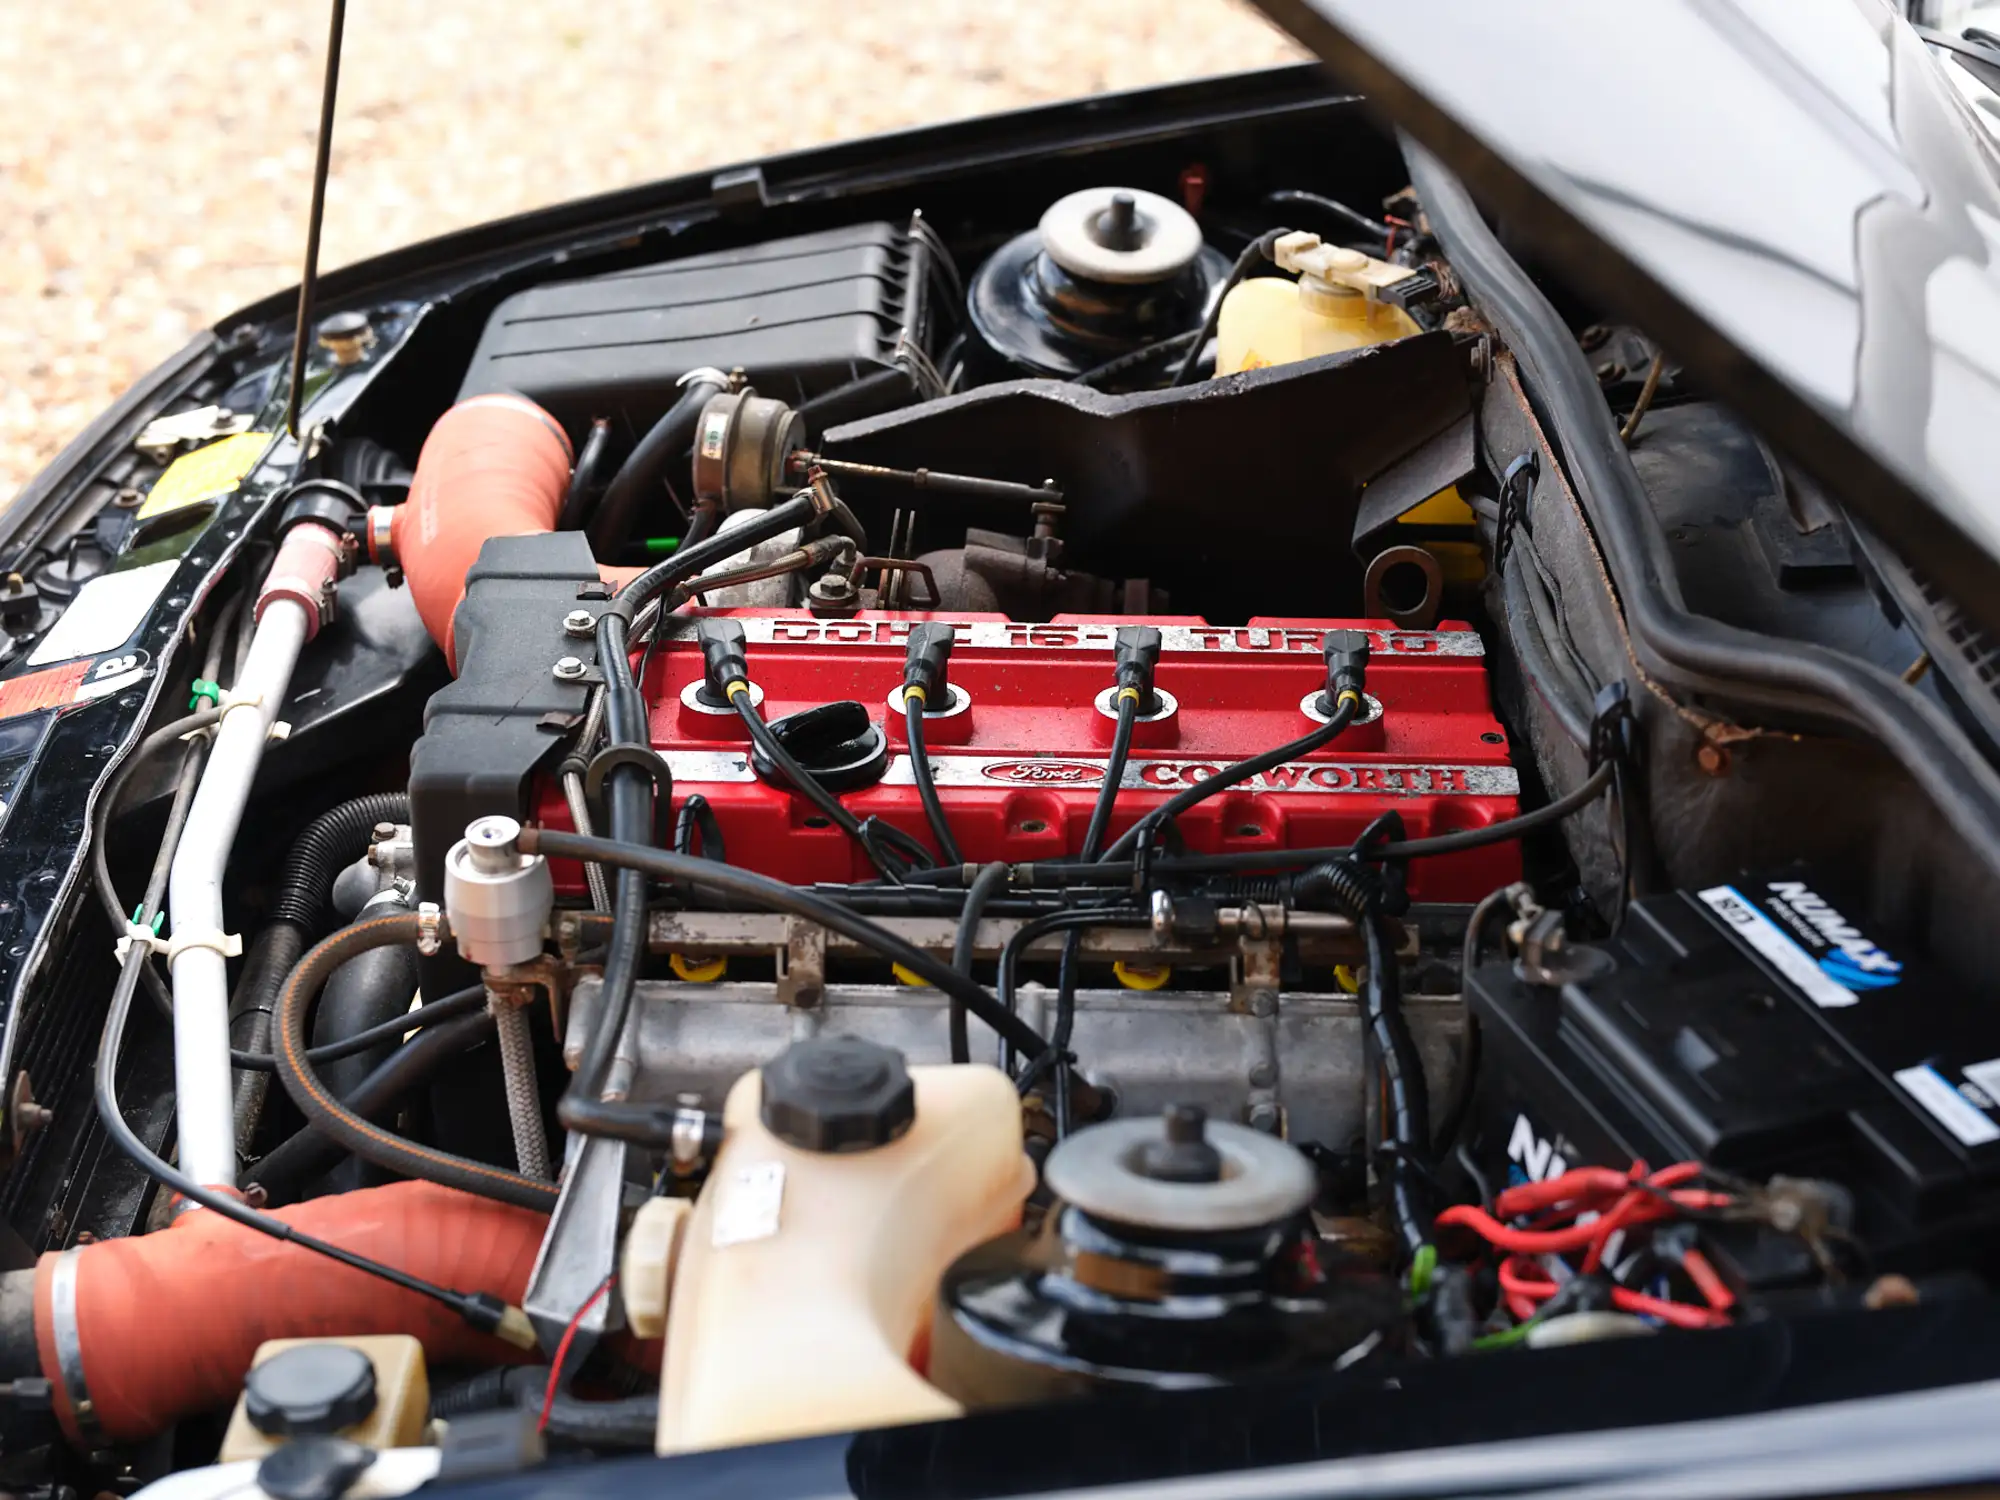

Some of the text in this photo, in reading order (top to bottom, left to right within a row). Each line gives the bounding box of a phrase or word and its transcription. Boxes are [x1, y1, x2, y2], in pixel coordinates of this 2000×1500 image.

[1009, 764, 1081, 780] Ford
[1140, 763, 1471, 792] COWORTH
[1767, 881, 1903, 972] NUMAX
